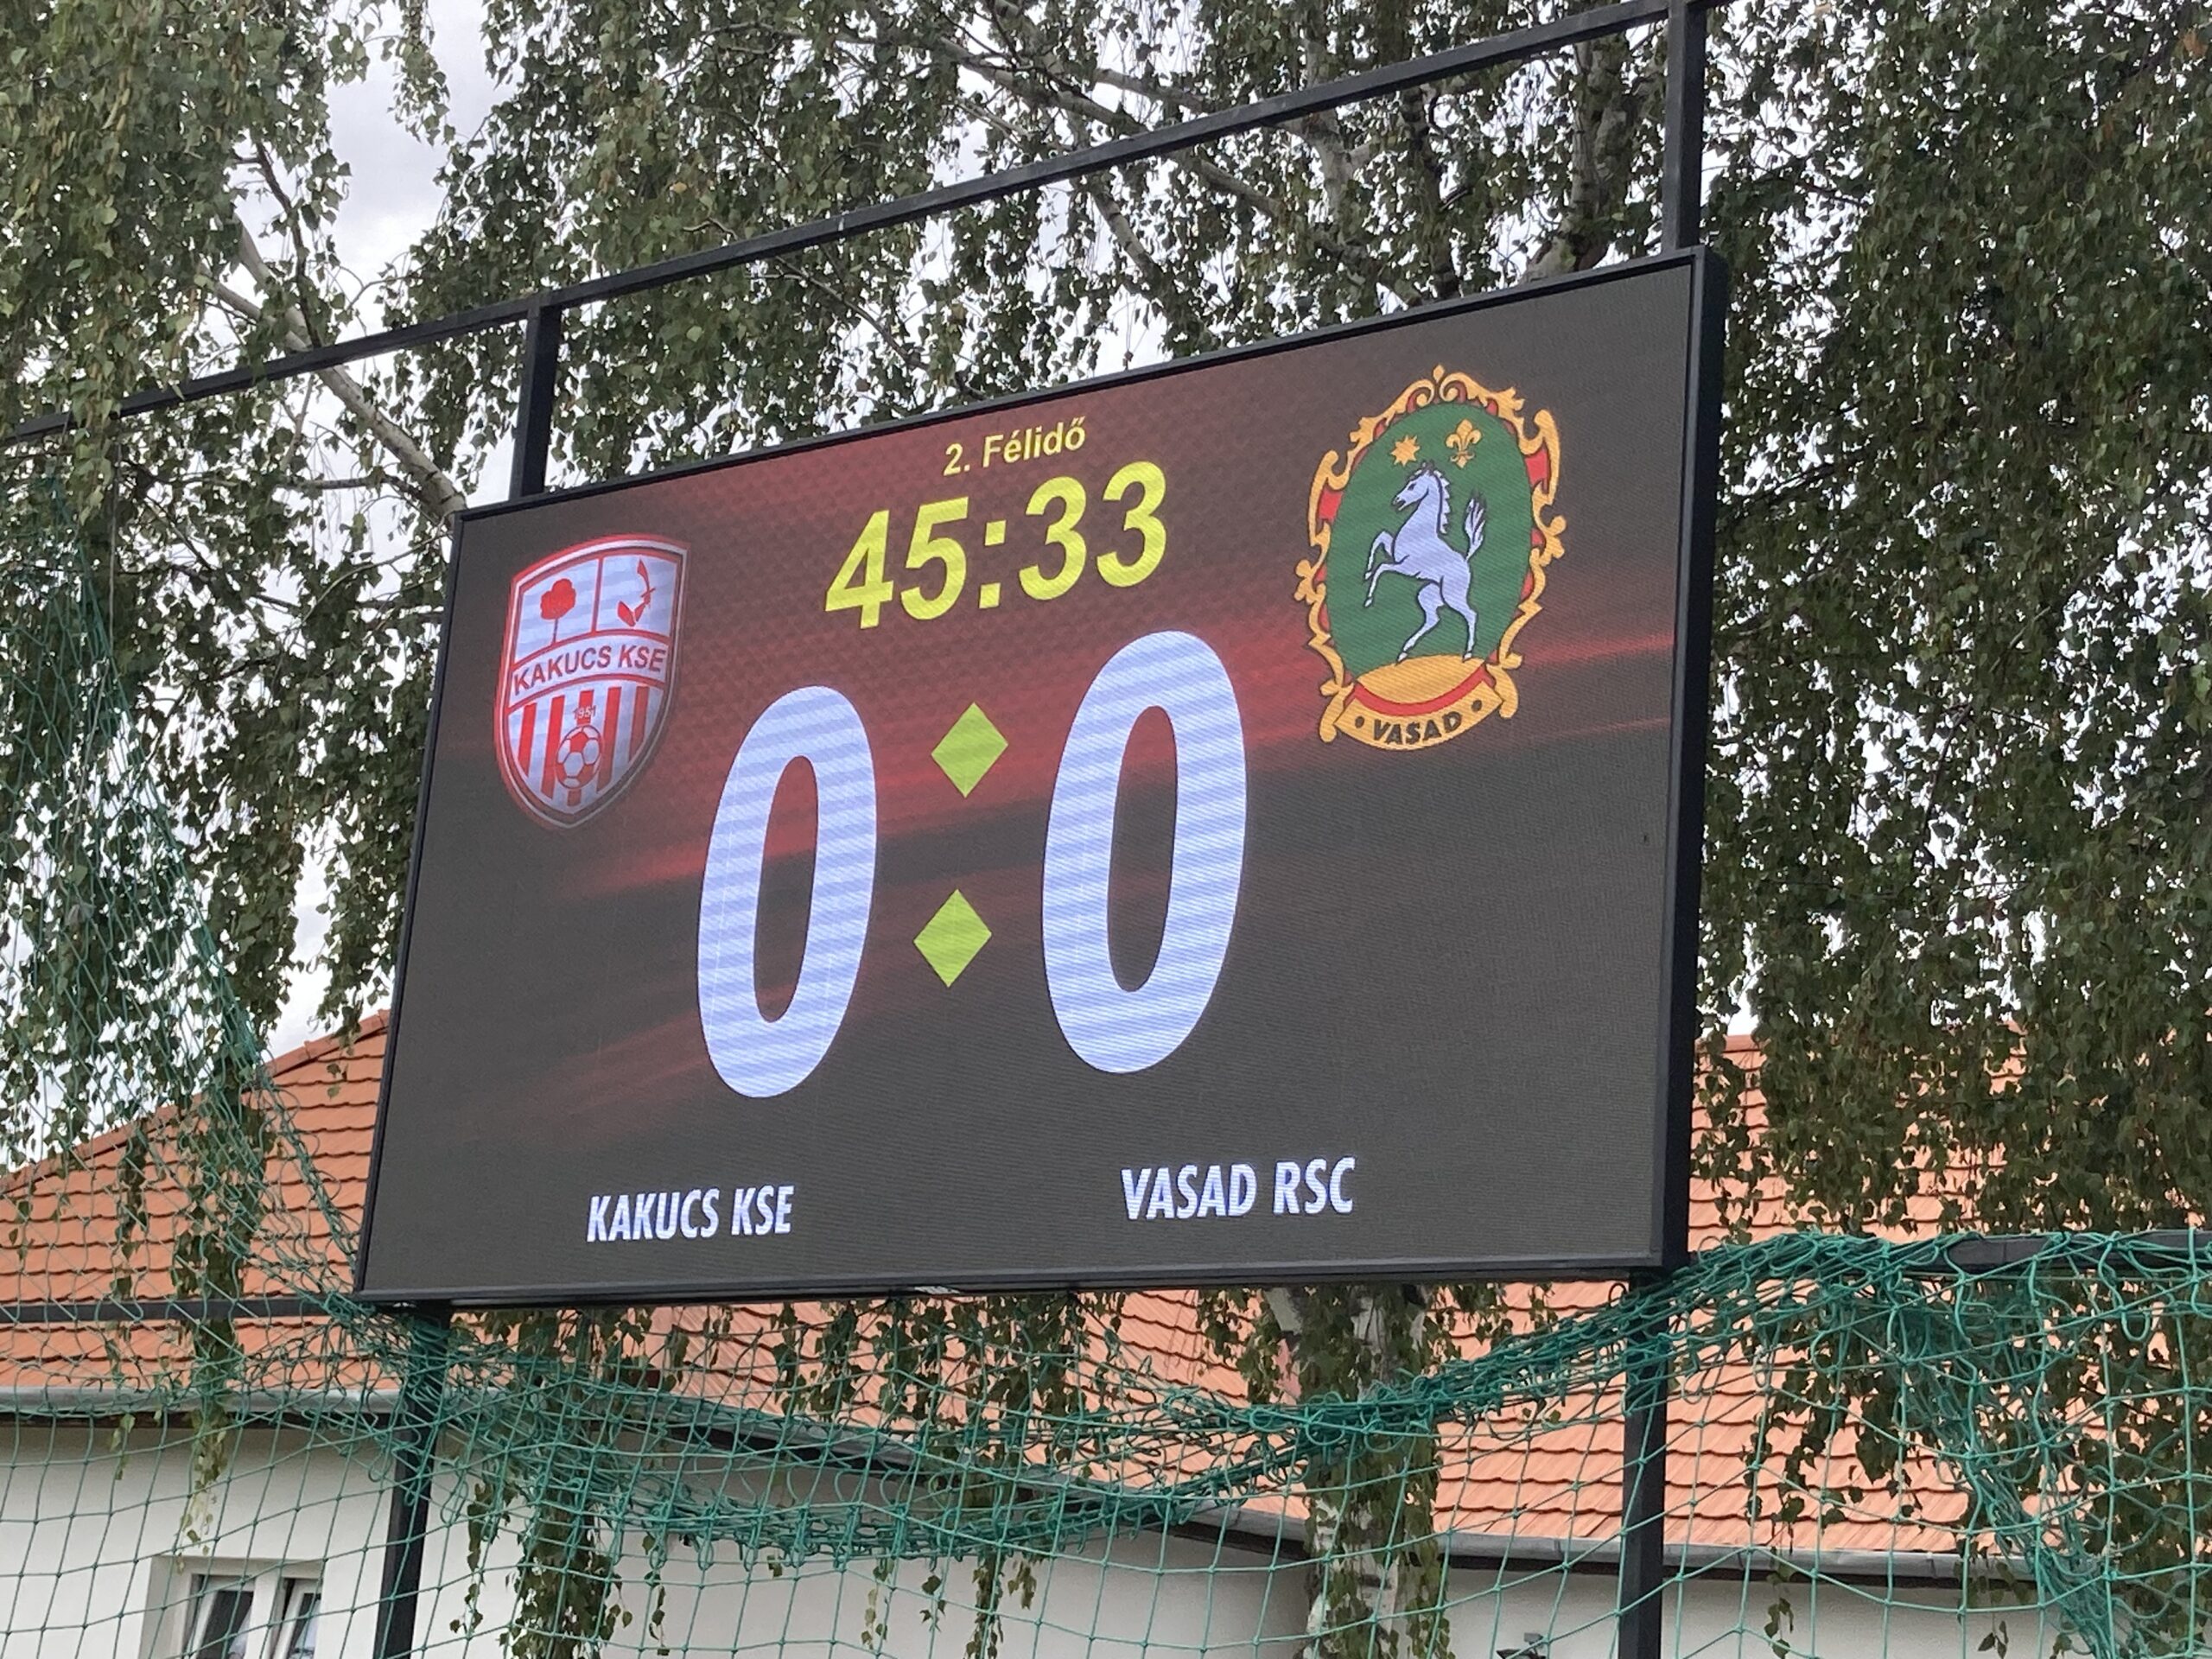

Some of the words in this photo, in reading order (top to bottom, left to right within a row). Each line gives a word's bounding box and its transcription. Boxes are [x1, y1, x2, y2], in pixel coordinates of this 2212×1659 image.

[944, 443, 971, 476] 2.
[982, 416, 1086, 467] Félidő
[825, 461, 1167, 629] 45:33
[514, 645, 612, 696] KAKUCS
[618, 644, 666, 673] KSE
[1374, 711, 1462, 744] VASAD
[697, 685, 877, 1097] 0
[1041, 630, 1246, 1073] 0
[587, 1188, 720, 1242] KAKUCS
[731, 1185, 794, 1236] KSE
[1122, 1164, 1257, 1219] VASAD
[1273, 1157, 1355, 1214] RSC
